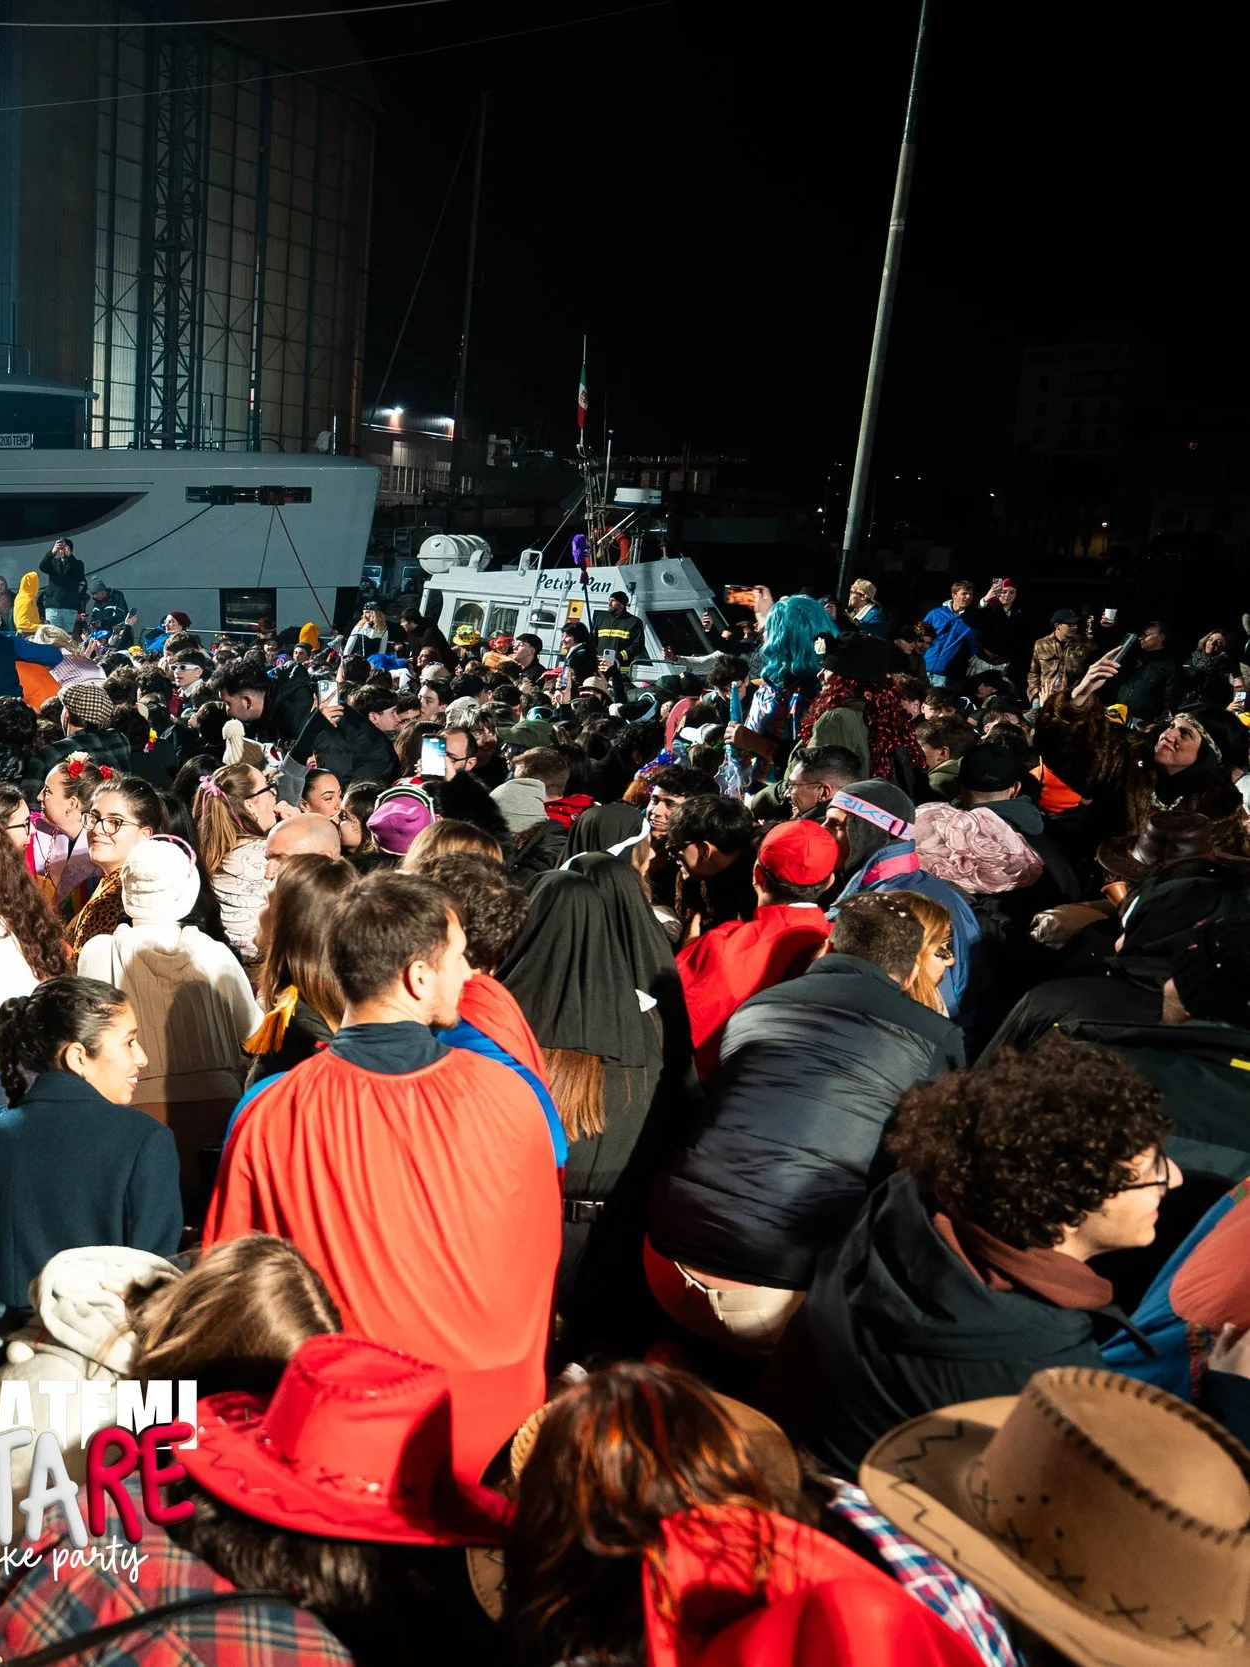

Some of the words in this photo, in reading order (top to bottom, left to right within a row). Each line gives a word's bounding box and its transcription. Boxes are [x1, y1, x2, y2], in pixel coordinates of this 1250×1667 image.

[12, 435, 29, 446] TEMP
[537, 573, 576, 590] Peter
[582, 577, 611, 592] Pan
